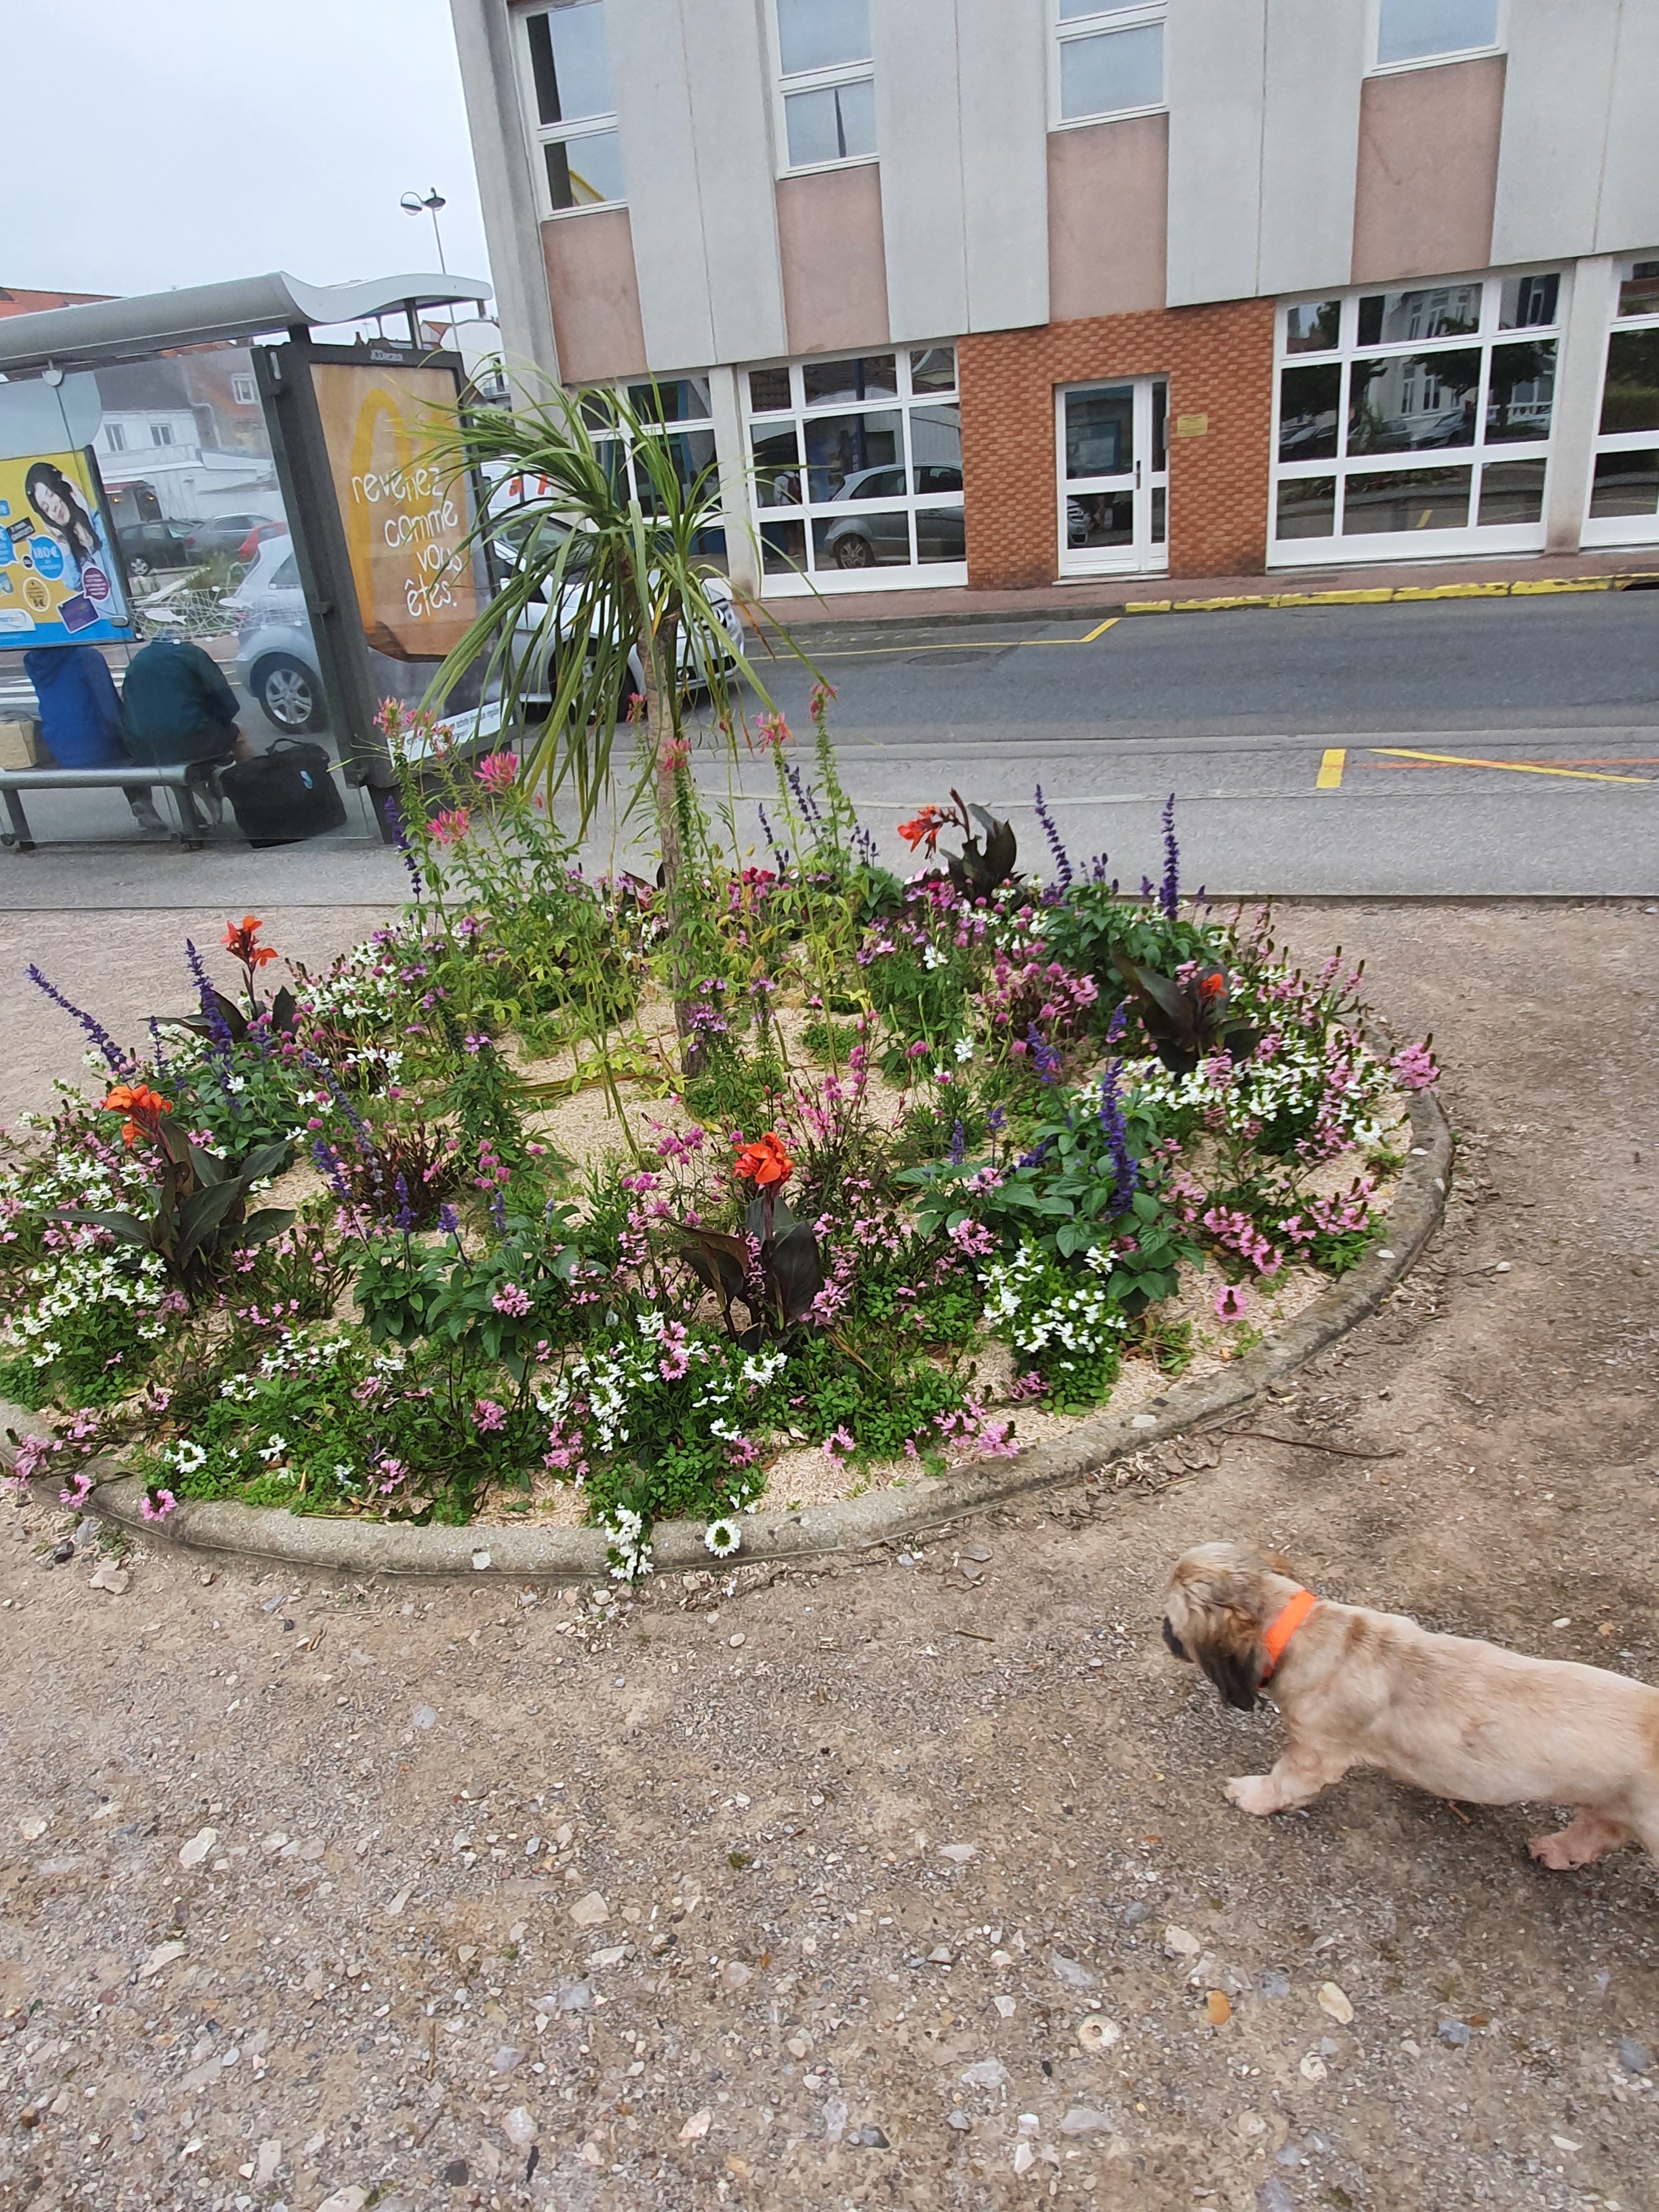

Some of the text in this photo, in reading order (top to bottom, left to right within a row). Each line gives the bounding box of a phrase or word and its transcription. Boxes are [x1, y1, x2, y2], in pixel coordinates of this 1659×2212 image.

[351, 467, 444, 504] revenez
[385, 500, 458, 548] comme
[416, 544, 462, 573] vous
[404, 573, 457, 617] êtes.
